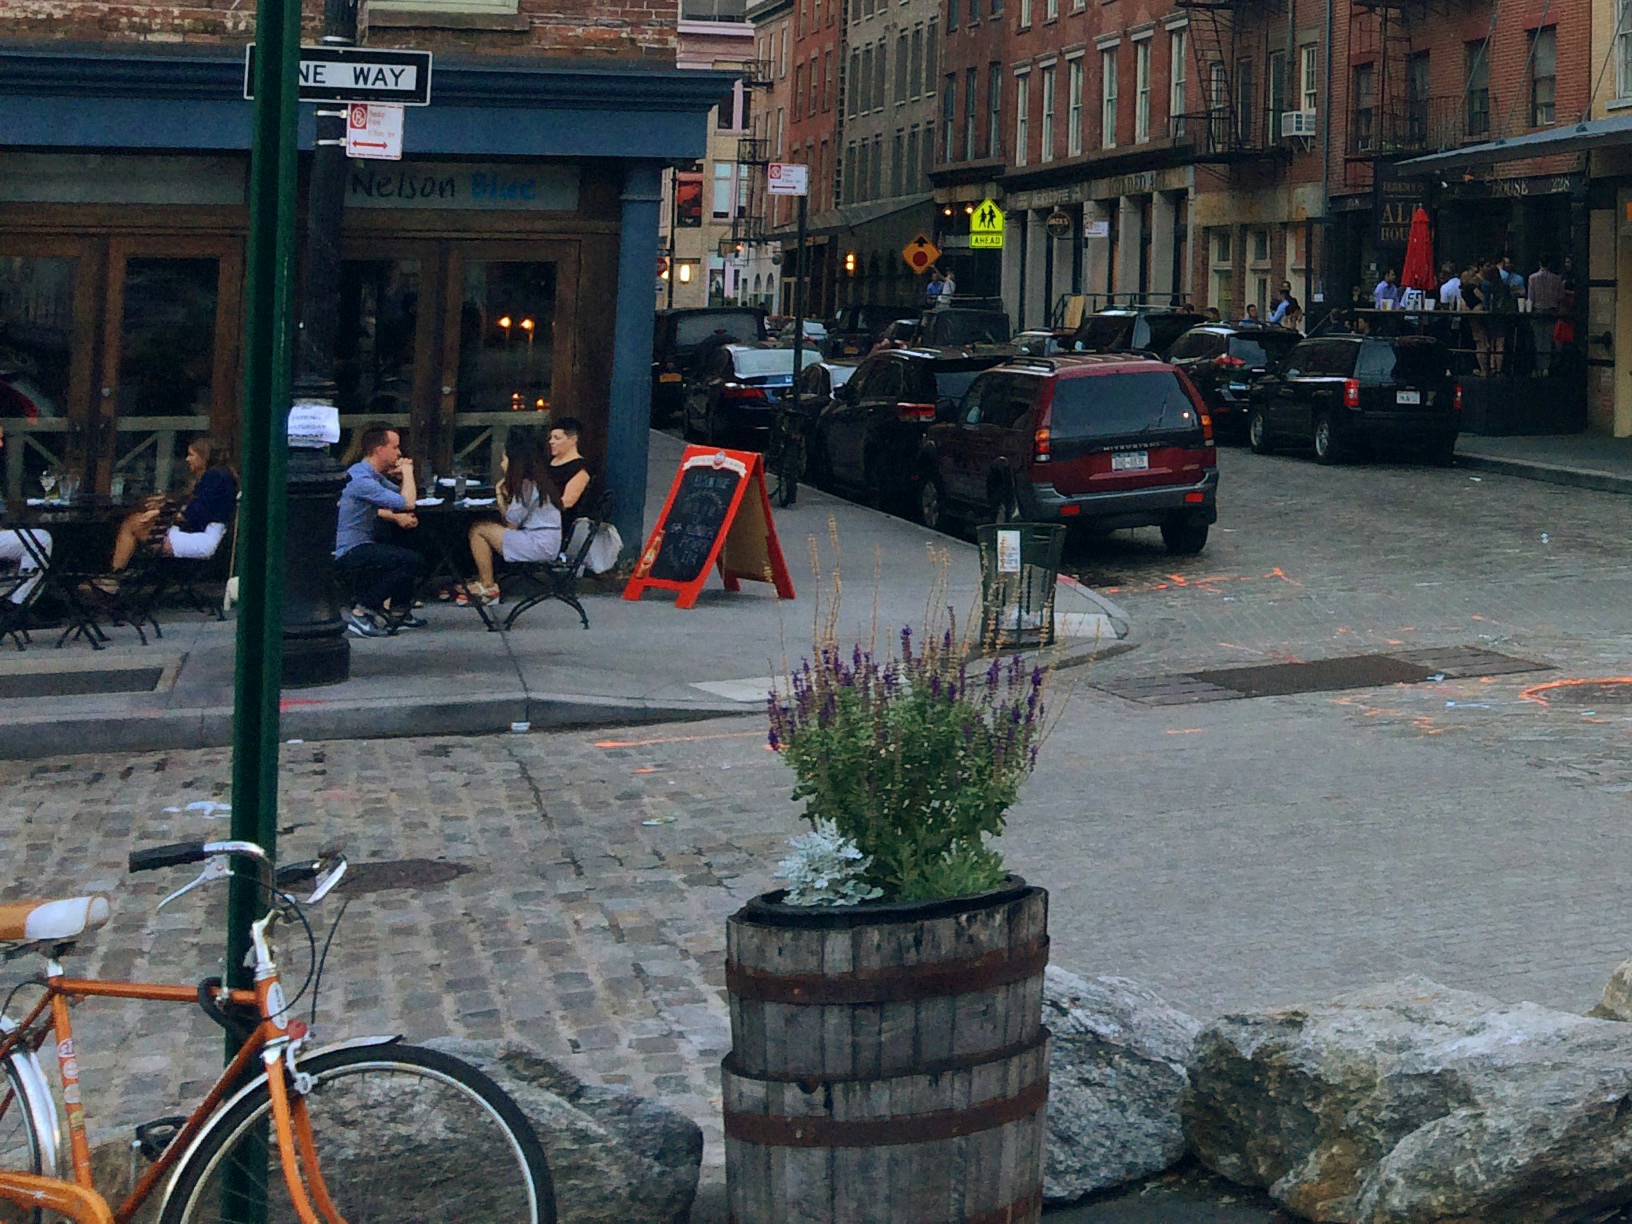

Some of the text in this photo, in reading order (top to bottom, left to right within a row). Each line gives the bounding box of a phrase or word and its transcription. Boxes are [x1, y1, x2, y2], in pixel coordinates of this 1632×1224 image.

[299, 64, 405, 87] NE WAY
[351, 171, 537, 201] Nelson Blue
[1493, 178, 1528, 196] HOUSE
[974, 236, 1001, 244] AHEAD
